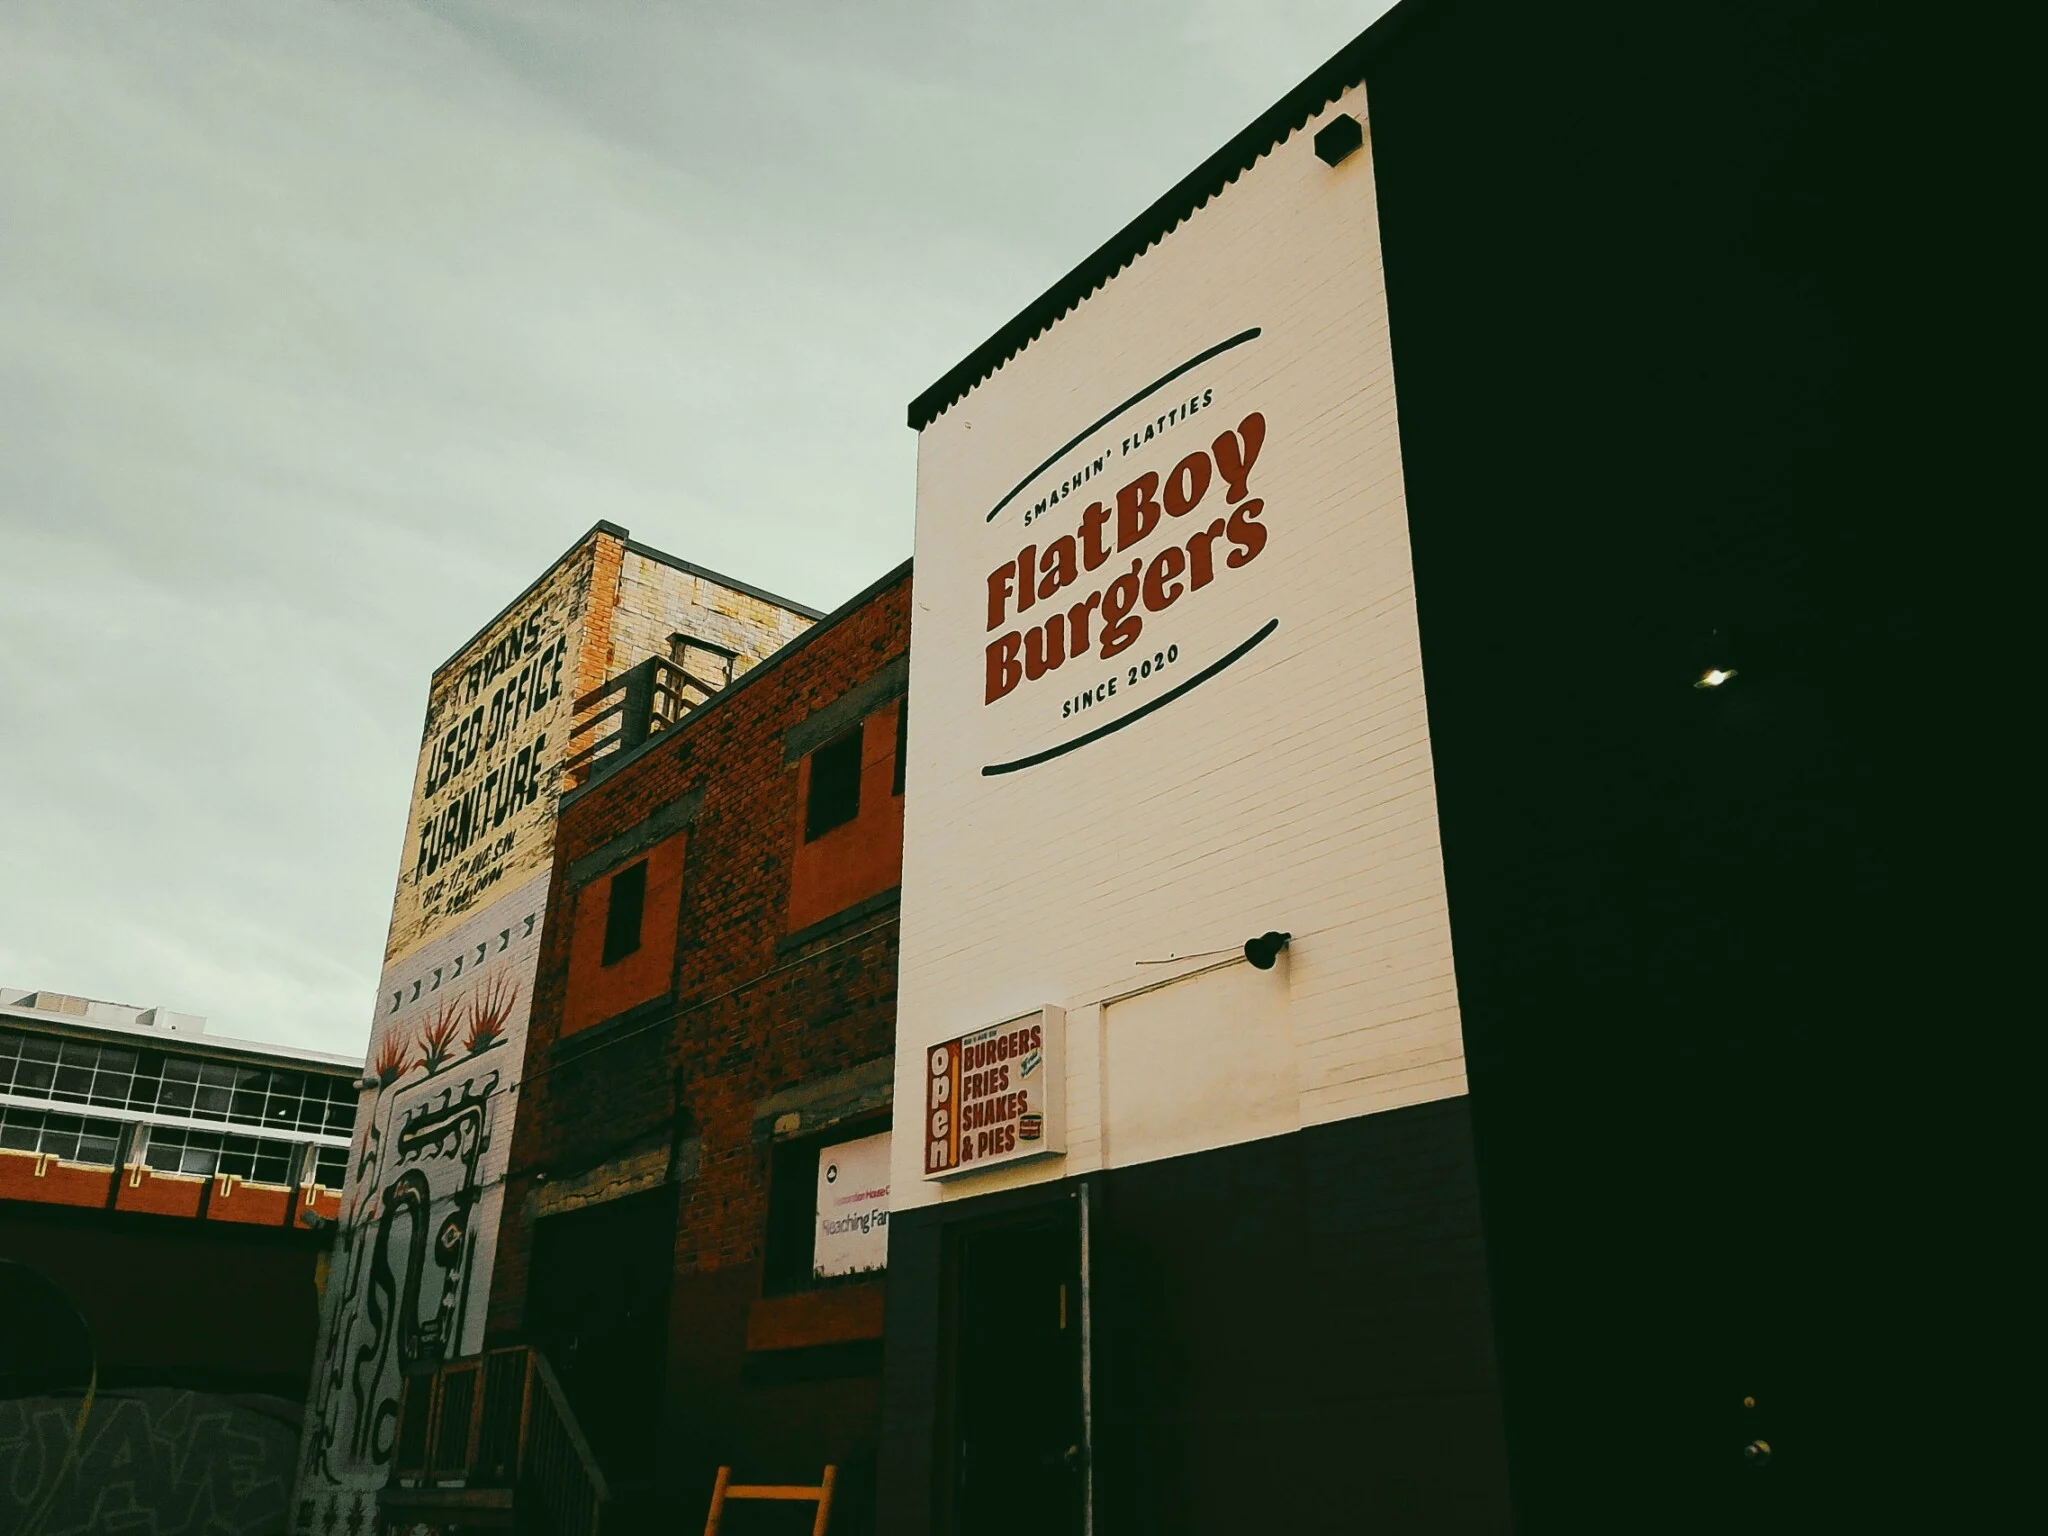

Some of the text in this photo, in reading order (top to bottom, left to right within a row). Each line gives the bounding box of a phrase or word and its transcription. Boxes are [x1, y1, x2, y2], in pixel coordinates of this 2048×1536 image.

[1023, 387, 1214, 528] SMASHIN' FLATTIES
[986, 411, 1267, 633] FlatBoy
[984, 497, 1269, 707] Burgers
[424, 634, 567, 800] USED OFFICE
[1061, 643, 1180, 719] SINCE 2020
[413, 732, 548, 887] FURNITURE
[929, 1046, 951, 1170] open
[961, 1089, 1029, 1132] SHAKES
[962, 1024, 1042, 1073] BURGERS
[962, 1063, 1020, 1102] FRIES
[960, 1134, 974, 1163] &
[977, 1123, 1016, 1159] PIES
